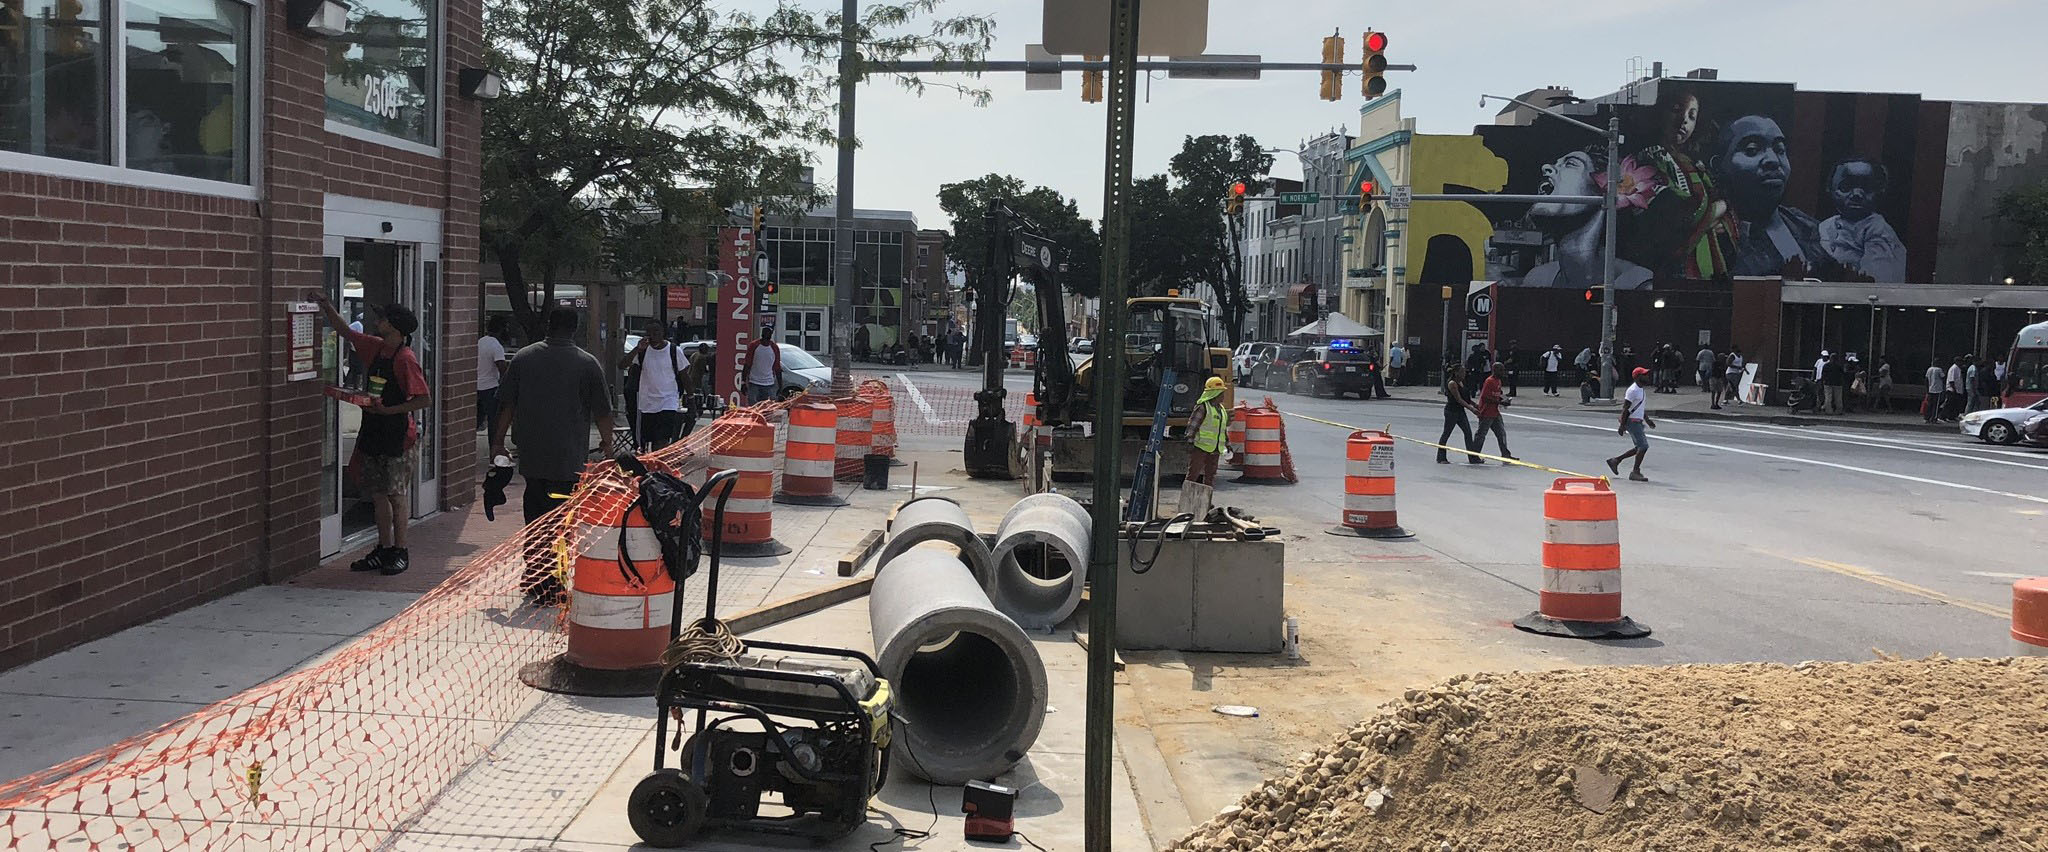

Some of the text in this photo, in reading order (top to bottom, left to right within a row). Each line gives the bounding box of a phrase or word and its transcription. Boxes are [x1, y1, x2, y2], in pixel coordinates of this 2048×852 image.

[1022, 241, 1036, 257] DEERE
[1477, 299, 1490, 312] M
[729, 227, 751, 408] Penn North
